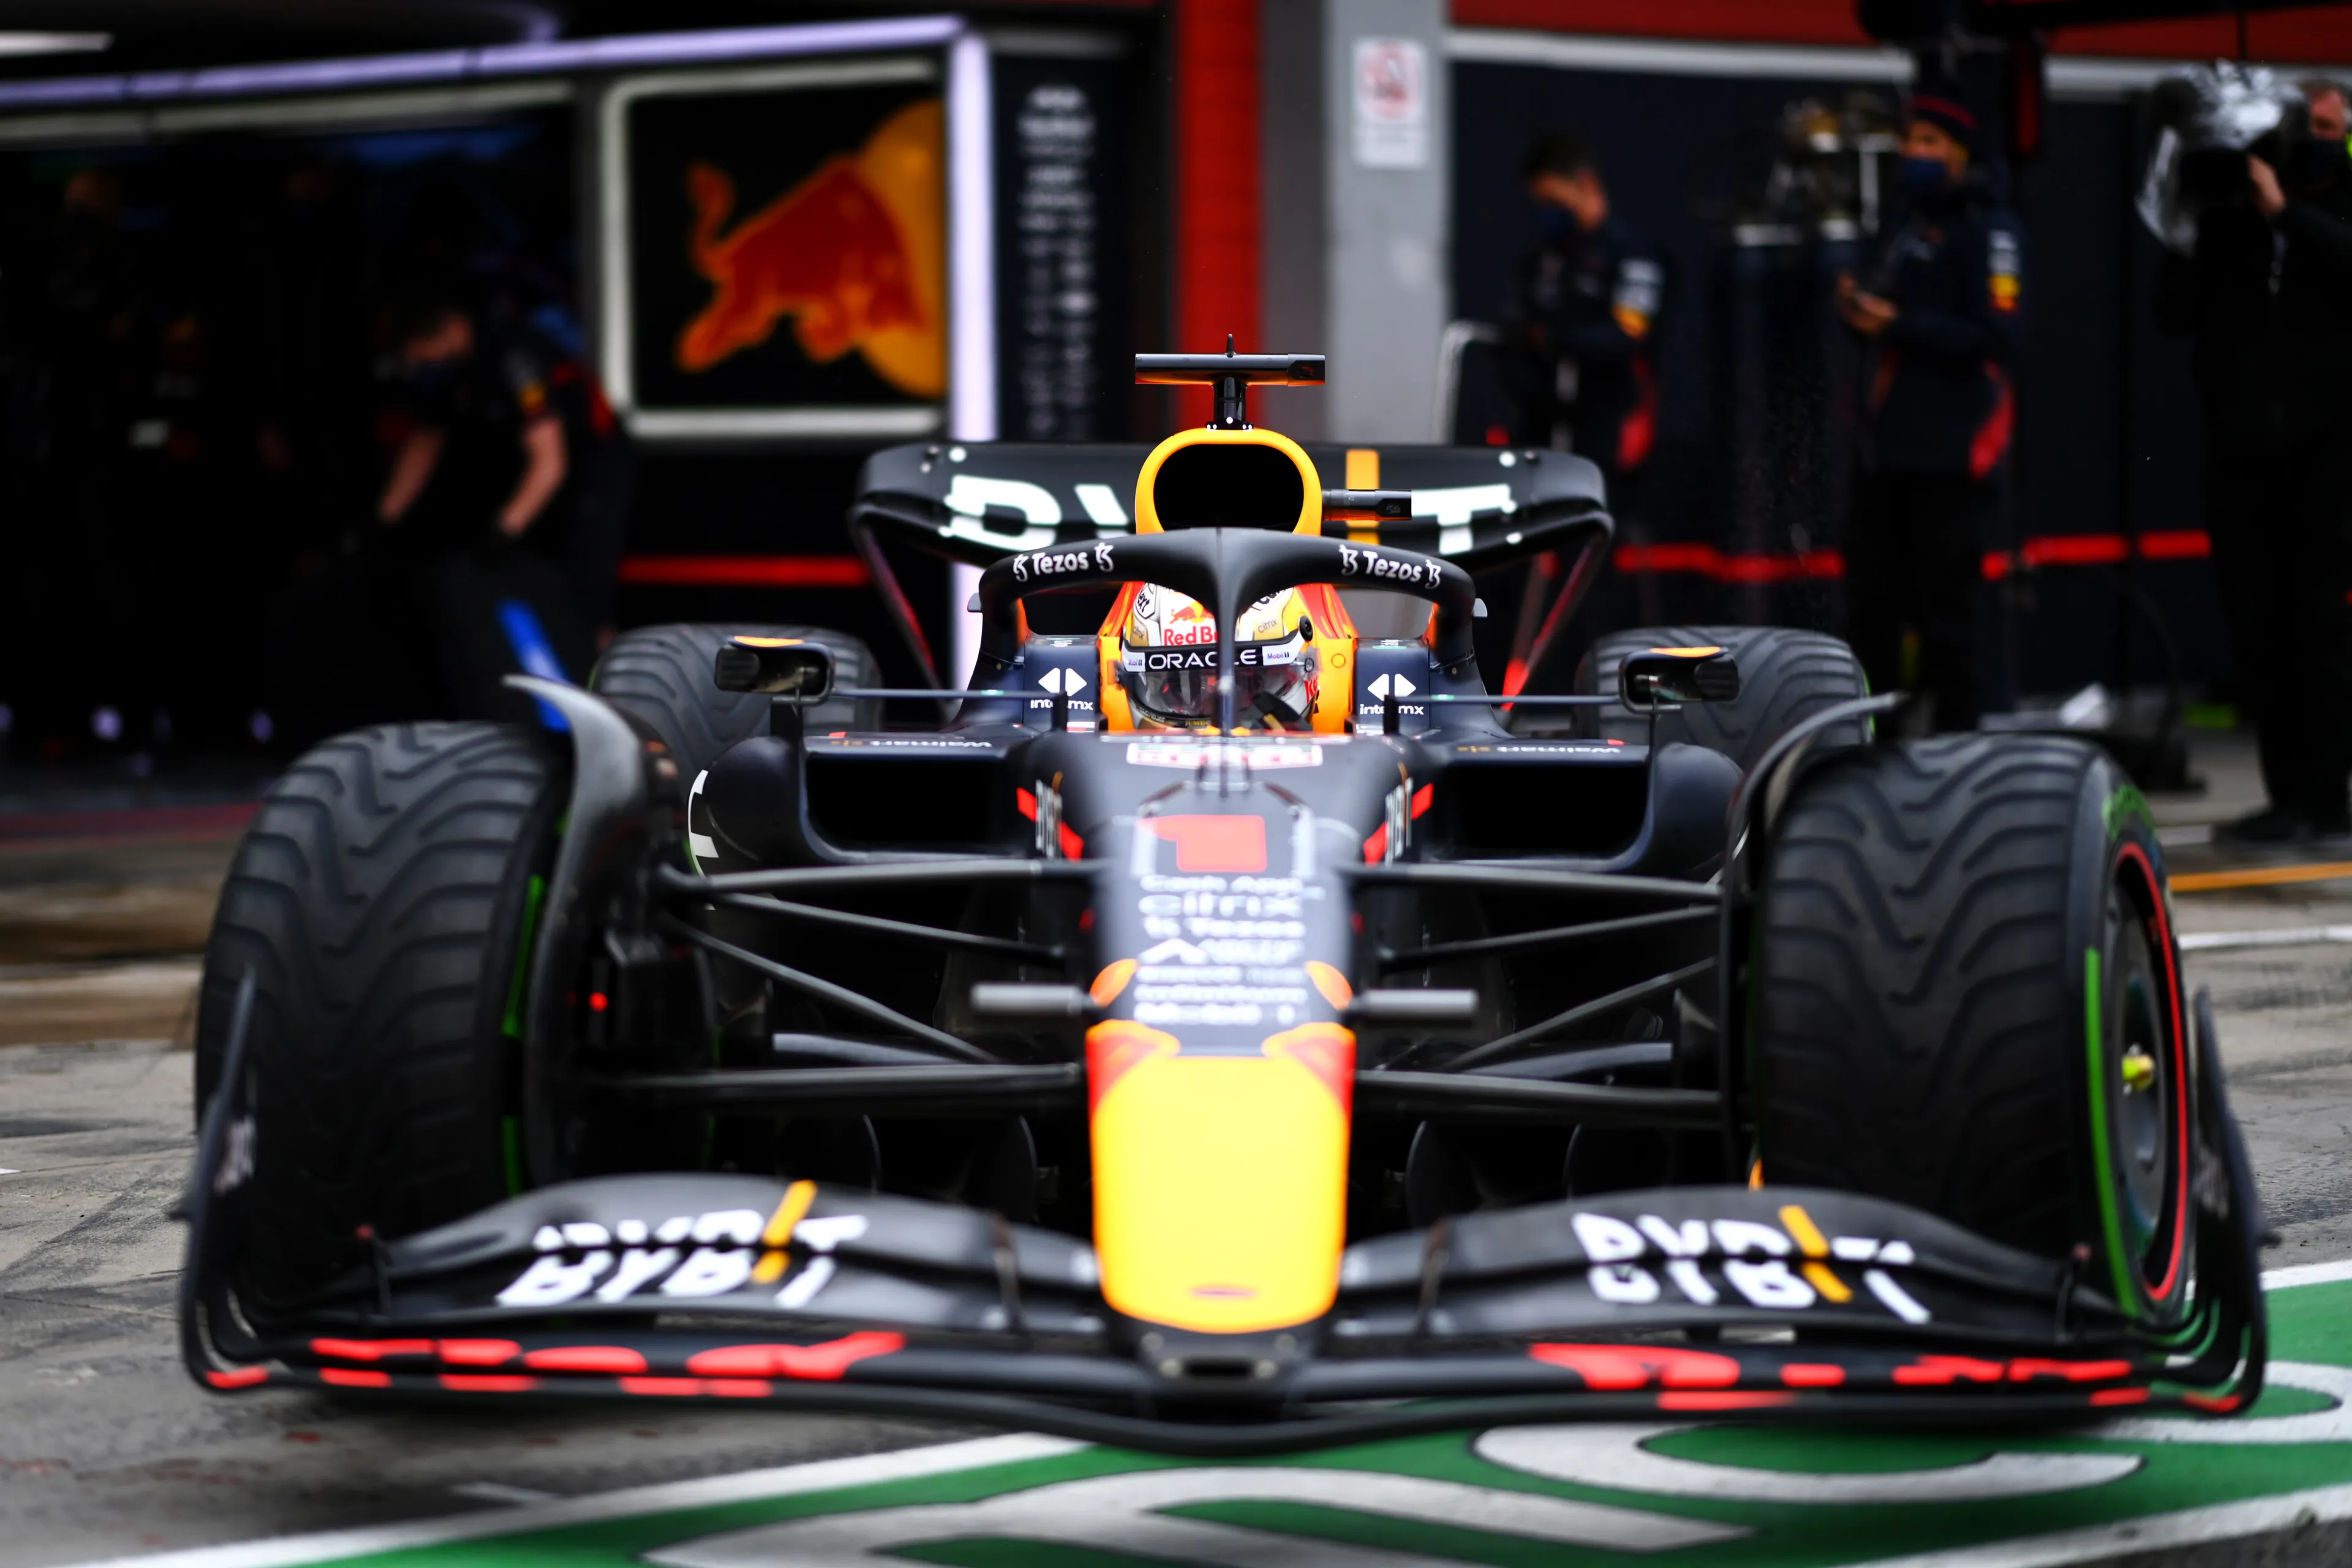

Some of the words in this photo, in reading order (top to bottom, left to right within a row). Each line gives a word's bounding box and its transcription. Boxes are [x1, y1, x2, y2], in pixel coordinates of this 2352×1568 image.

[1031, 552, 1089, 575] Tezos
[1363, 550, 1422, 582] Tezos
[1164, 625, 1196, 646] Red
[1257, 618, 1278, 633] citrix
[1148, 649, 1257, 669] ORACE
